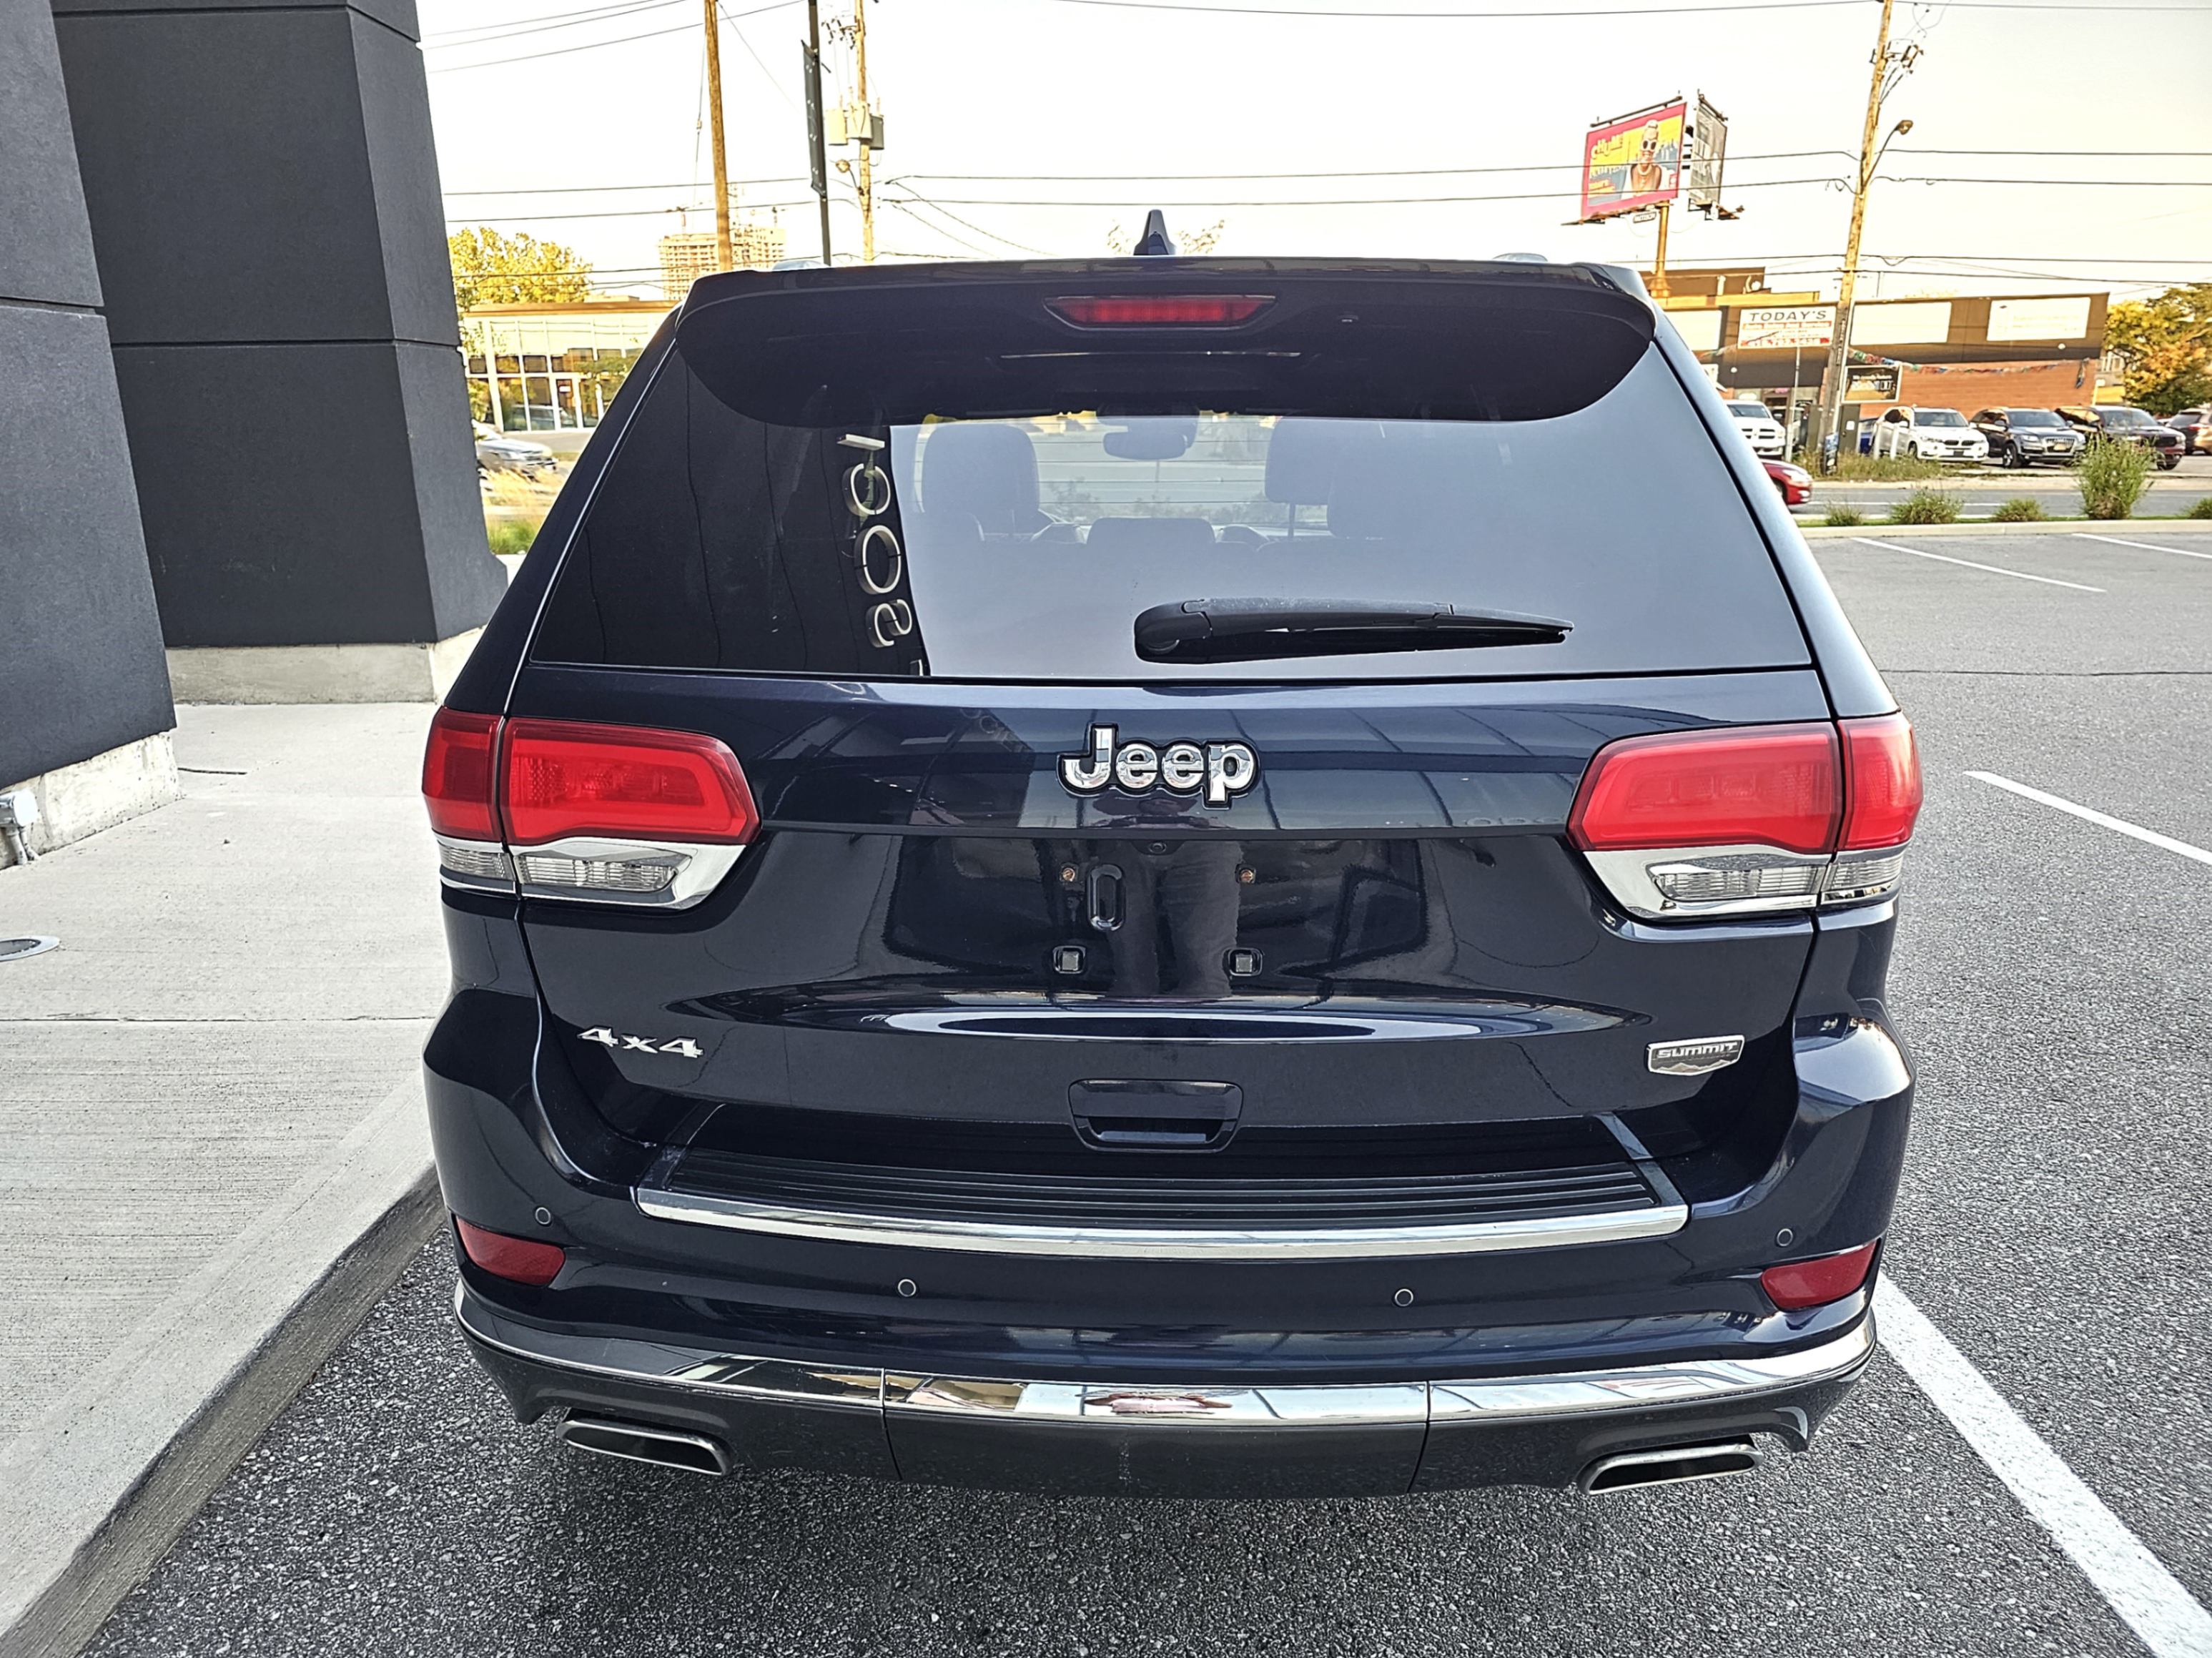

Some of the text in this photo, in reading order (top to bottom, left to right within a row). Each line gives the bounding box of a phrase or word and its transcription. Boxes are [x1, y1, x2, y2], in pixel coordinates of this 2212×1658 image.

[1750, 310, 1827, 322] TODAY'S
[1062, 726, 1256, 802] Jeep
[1656, 1041, 1738, 1059] SUMMIT
